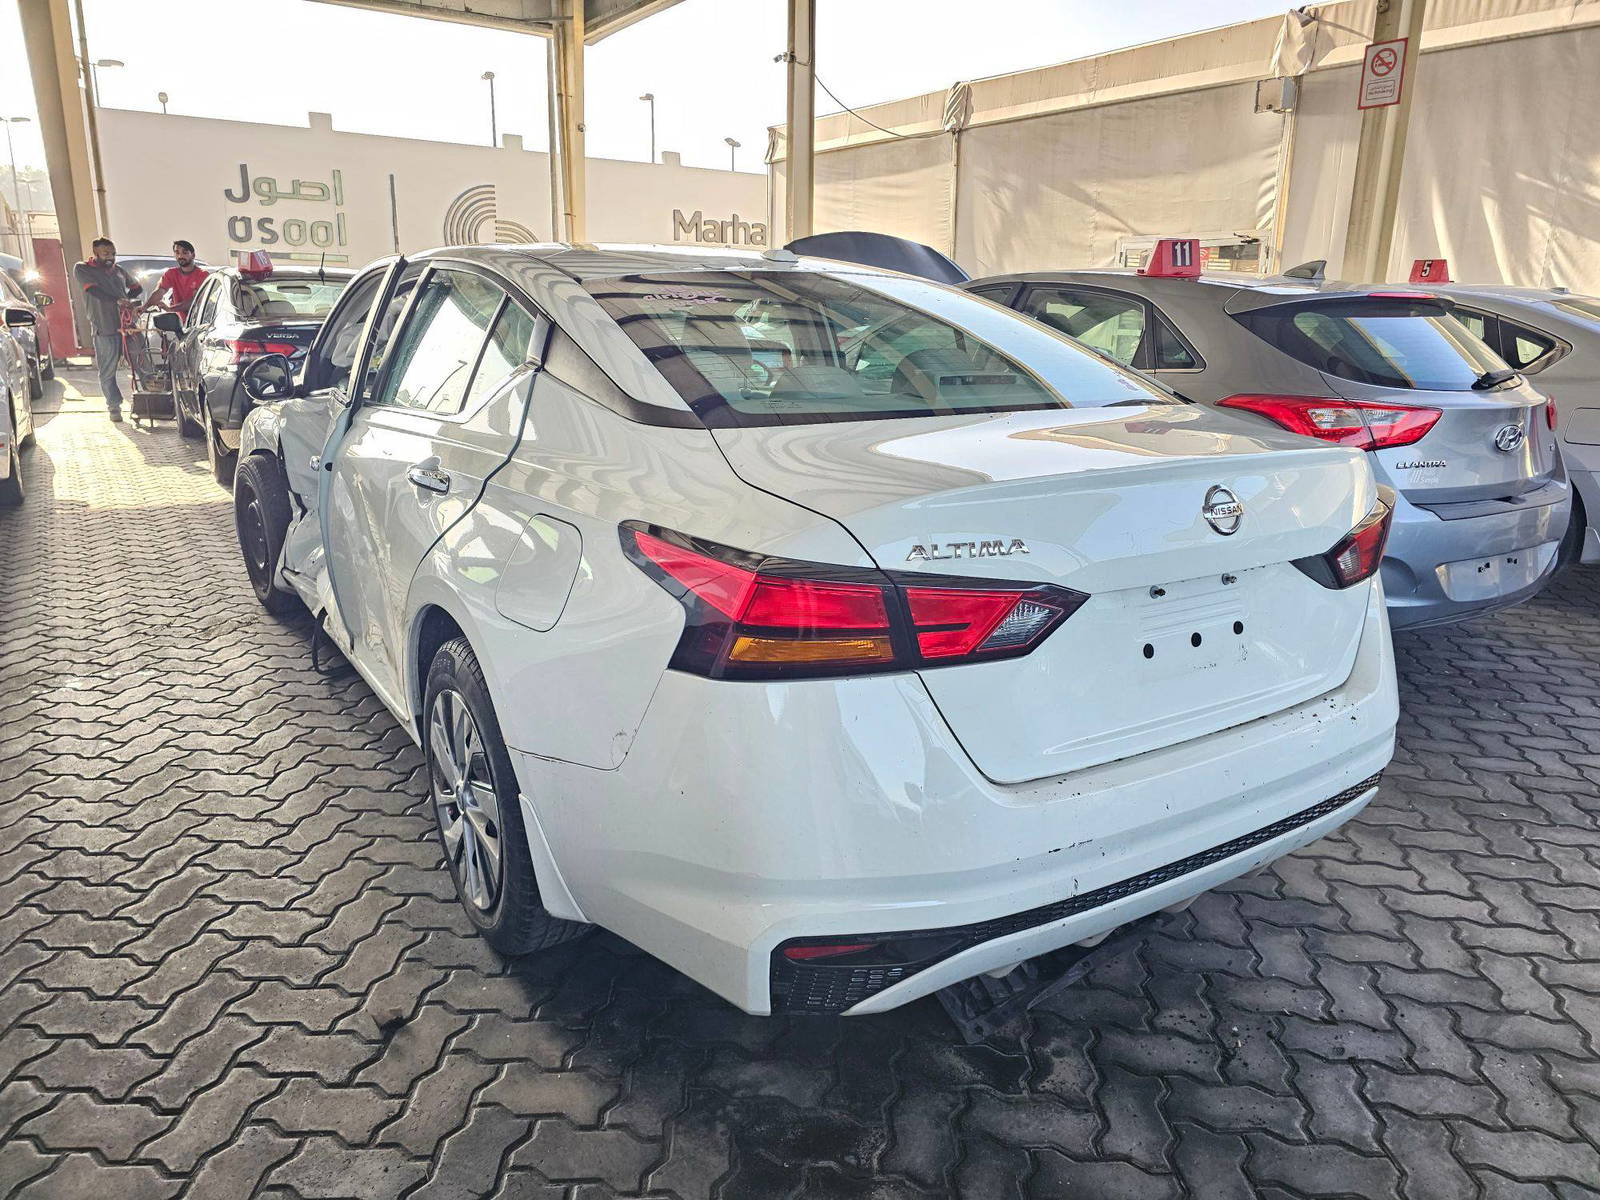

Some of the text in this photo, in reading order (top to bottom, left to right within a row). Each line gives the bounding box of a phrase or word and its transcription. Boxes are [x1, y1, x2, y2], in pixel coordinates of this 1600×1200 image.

[672, 209, 766, 246] Marha
[1174, 241, 1191, 267] 11
[1421, 260, 1433, 277] 5
[1395, 460, 1446, 469] ELANTRA
[1210, 503, 1243, 516] NISSAN
[906, 539, 1030, 561] ALTIMA
